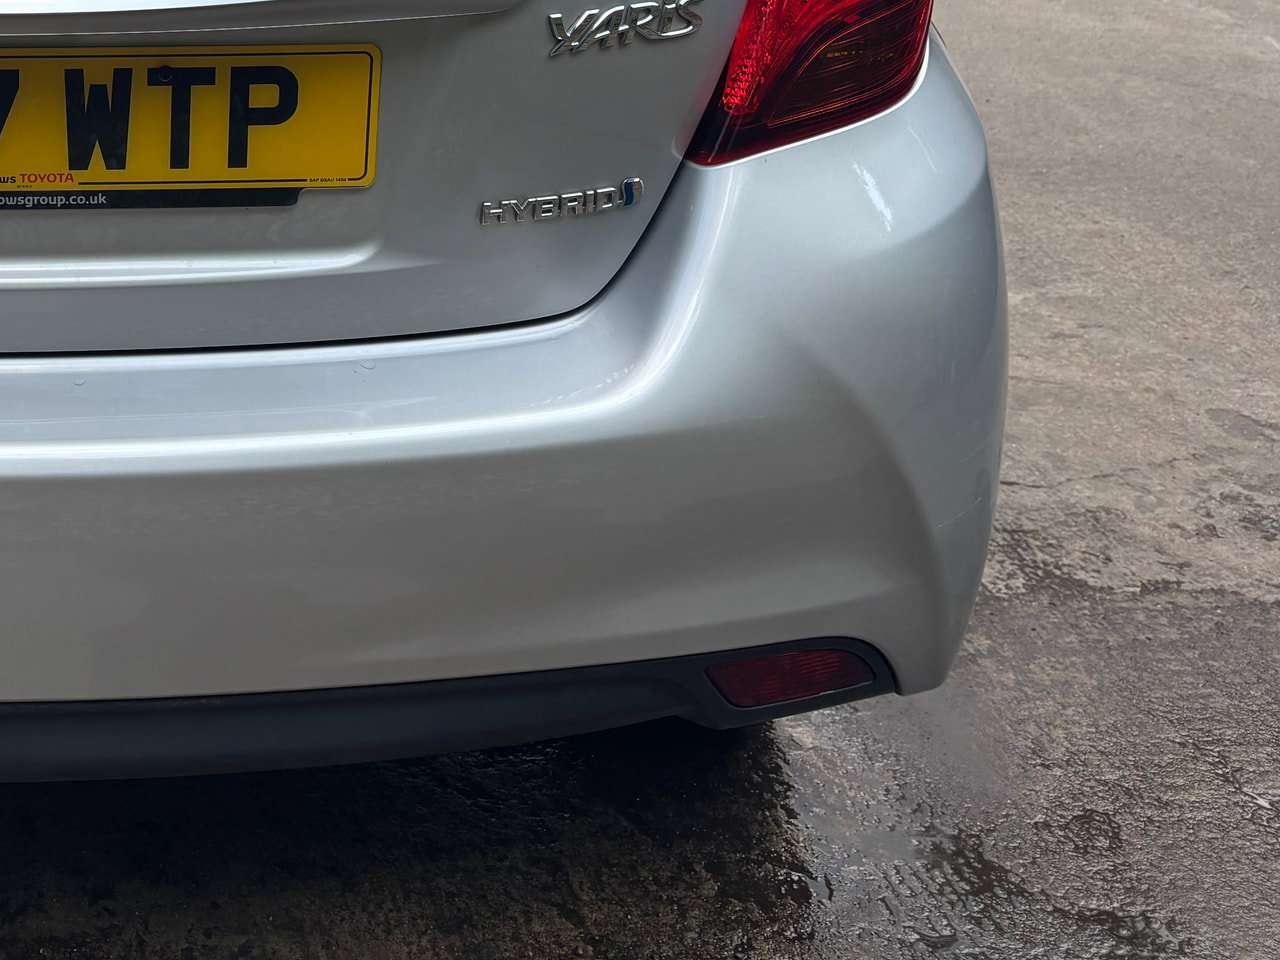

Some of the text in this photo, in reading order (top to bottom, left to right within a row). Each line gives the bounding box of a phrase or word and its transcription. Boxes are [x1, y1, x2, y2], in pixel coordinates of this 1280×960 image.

[64, 65, 299, 171] WTP
[19, 173, 74, 184] TOYOTA
[480, 187, 617, 225] HYBRID
